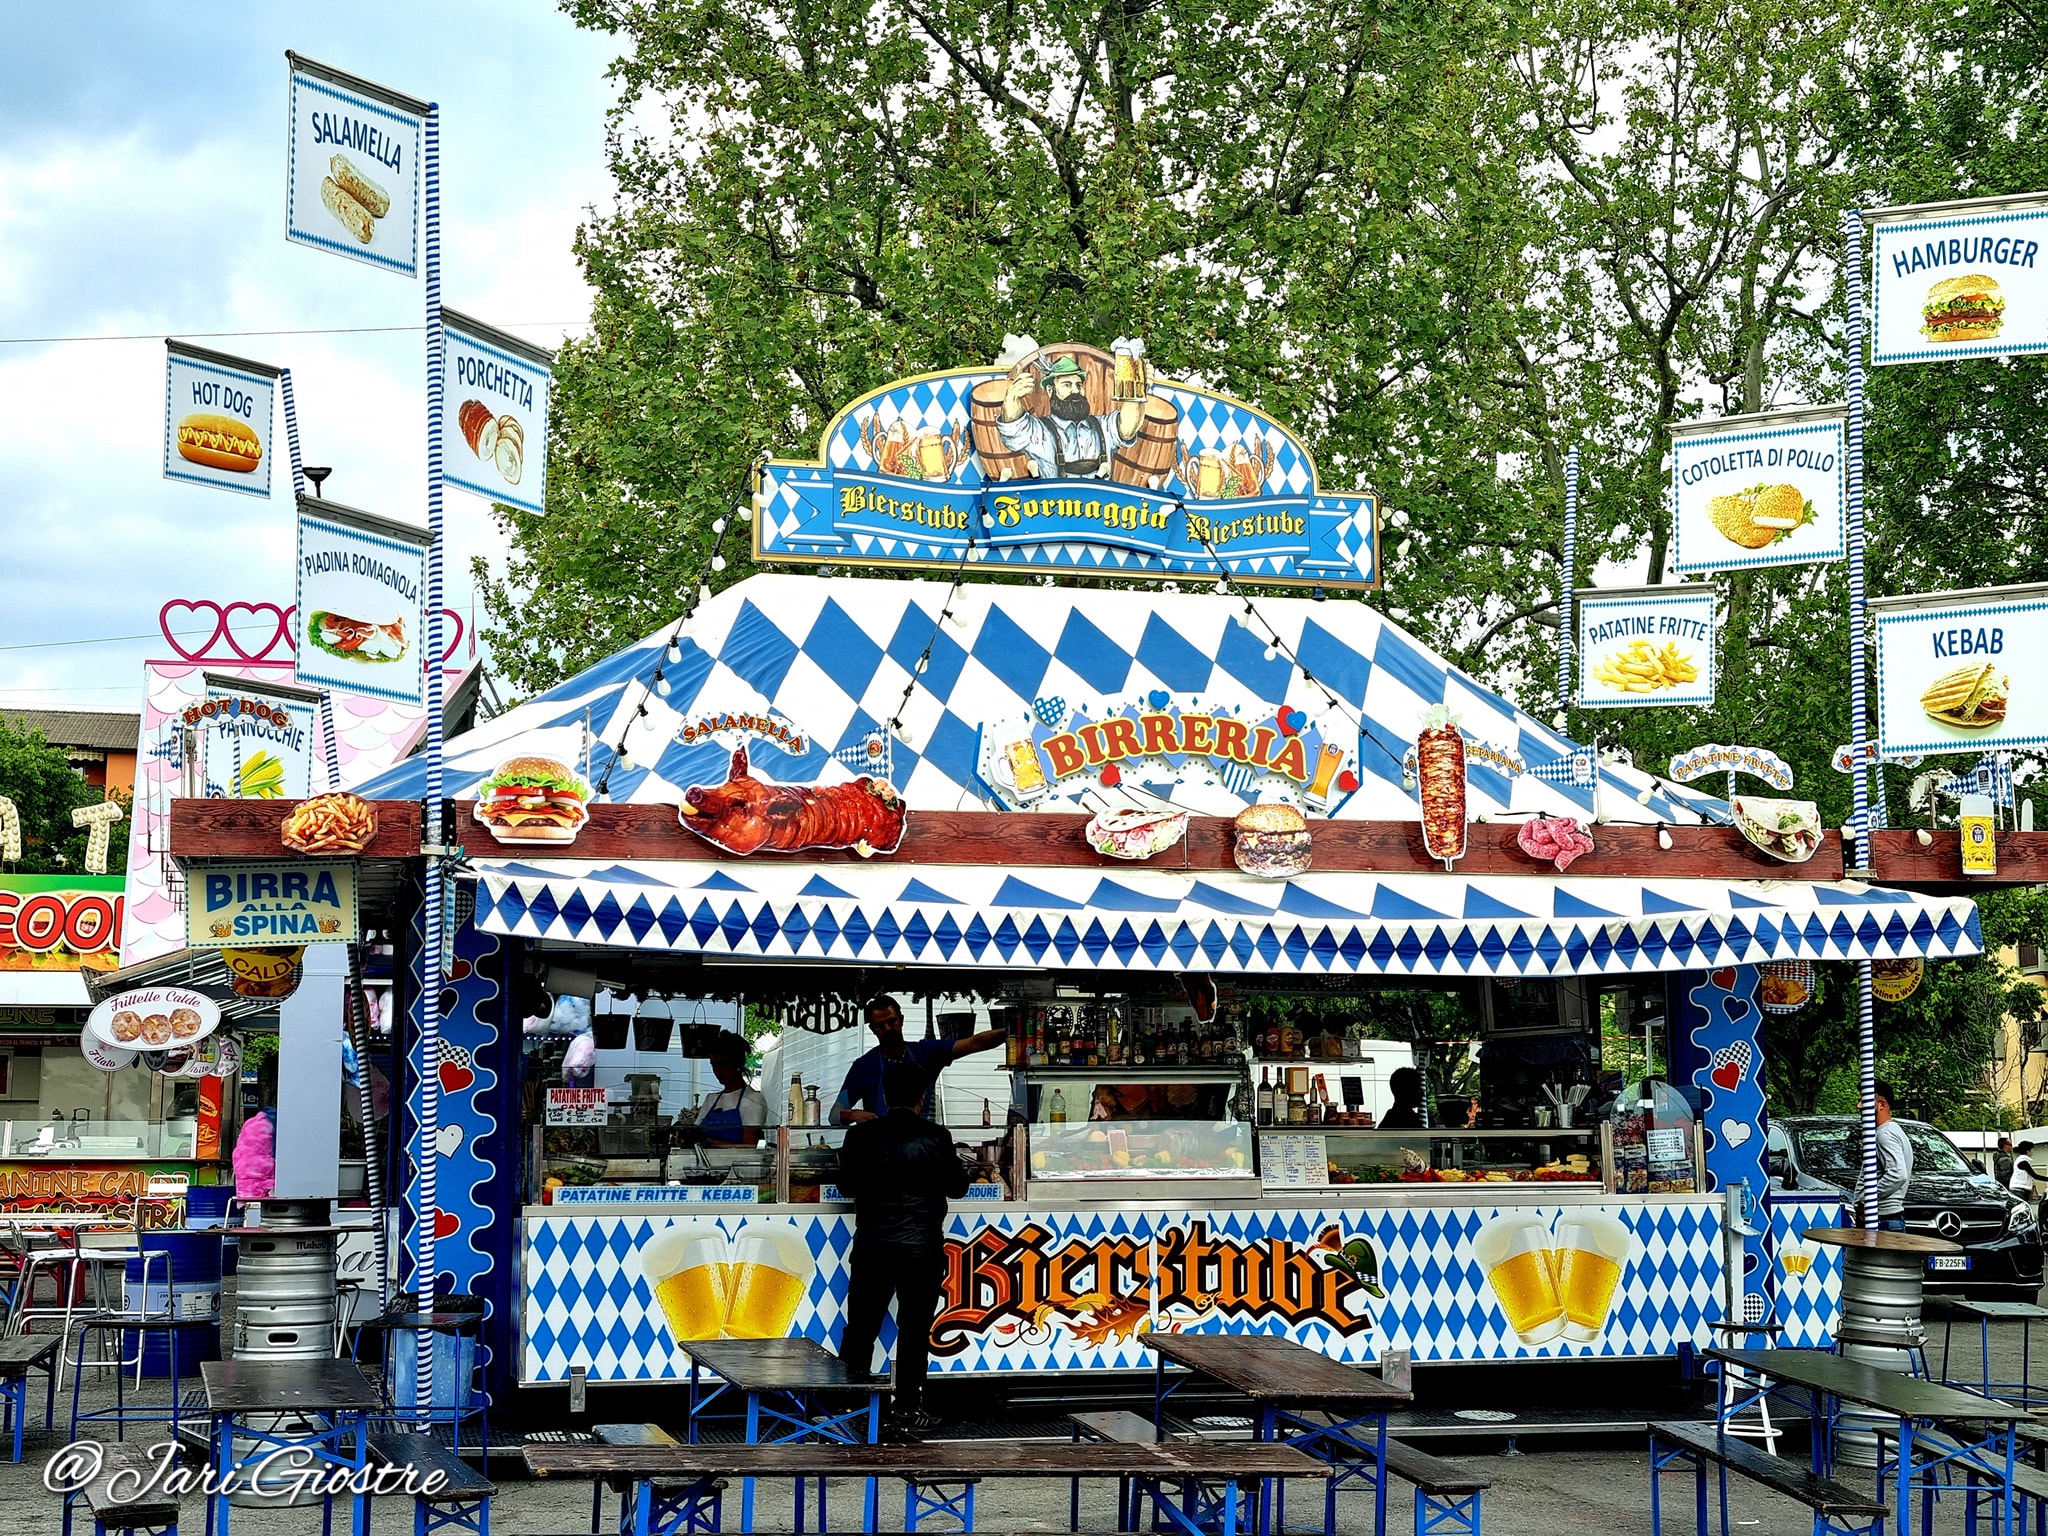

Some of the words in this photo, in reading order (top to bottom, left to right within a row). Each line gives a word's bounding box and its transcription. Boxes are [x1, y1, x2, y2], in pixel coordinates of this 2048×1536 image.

[311, 110, 402, 175] SALAMELLA
[1892, 235, 2039, 278] HAMBURGER
[191, 380, 221, 407] HOT
[224, 386, 254, 419] DOG
[457, 355, 533, 412] PORCHETTA
[1681, 449, 1764, 487] COTOLETTA
[1768, 448, 1783, 467] DI
[1786, 448, 1835, 474] POLLO
[839, 486, 969, 532] Bierstube
[995, 494, 1170, 532] Formaggia
[1185, 509, 1307, 547] Bierstube
[305, 550, 351, 578] PIADINA
[353, 553, 418, 605] ROMAGNOLA
[1589, 615, 1656, 645] PATATINE
[1659, 613, 1708, 643] FRITTE
[1932, 626, 2004, 659] KEBAB
[182, 698, 235, 726] HOT
[238, 696, 289, 729] DOG
[682, 714, 802, 753] SALAMELLA
[1041, 712, 1310, 783] BIRRERIA
[1465, 744, 1522, 775] GETARIANA
[1676, 751, 1740, 780] PATATINE
[1743, 753, 1789, 788] FRITTE
[205, 870, 341, 914] BIRRA
[242, 902, 308, 912] ALLA
[233, 914, 320, 937] SPINA
[232, 956, 297, 980] CALDI
[110, 991, 162, 1012] Frittelle
[165, 990, 202, 1008] Calde
[1872, 984, 1894, 1000] tatine
[88, 1049, 117, 1068] Filato
[189, 1065, 210, 1074] ibite
[550, 1088, 581, 1104] PATATINE
[582, 1088, 606, 1104] FRITTE
[0, 1171, 88, 1197] ANINI
[560, 1189, 631, 1202] PATATINE
[635, 1188, 689, 1201] FRITTE
[701, 1187, 752, 1200] KEBAB
[965, 1187, 999, 1198] RDURE
[929, 1219, 1374, 1358] Bierstube
